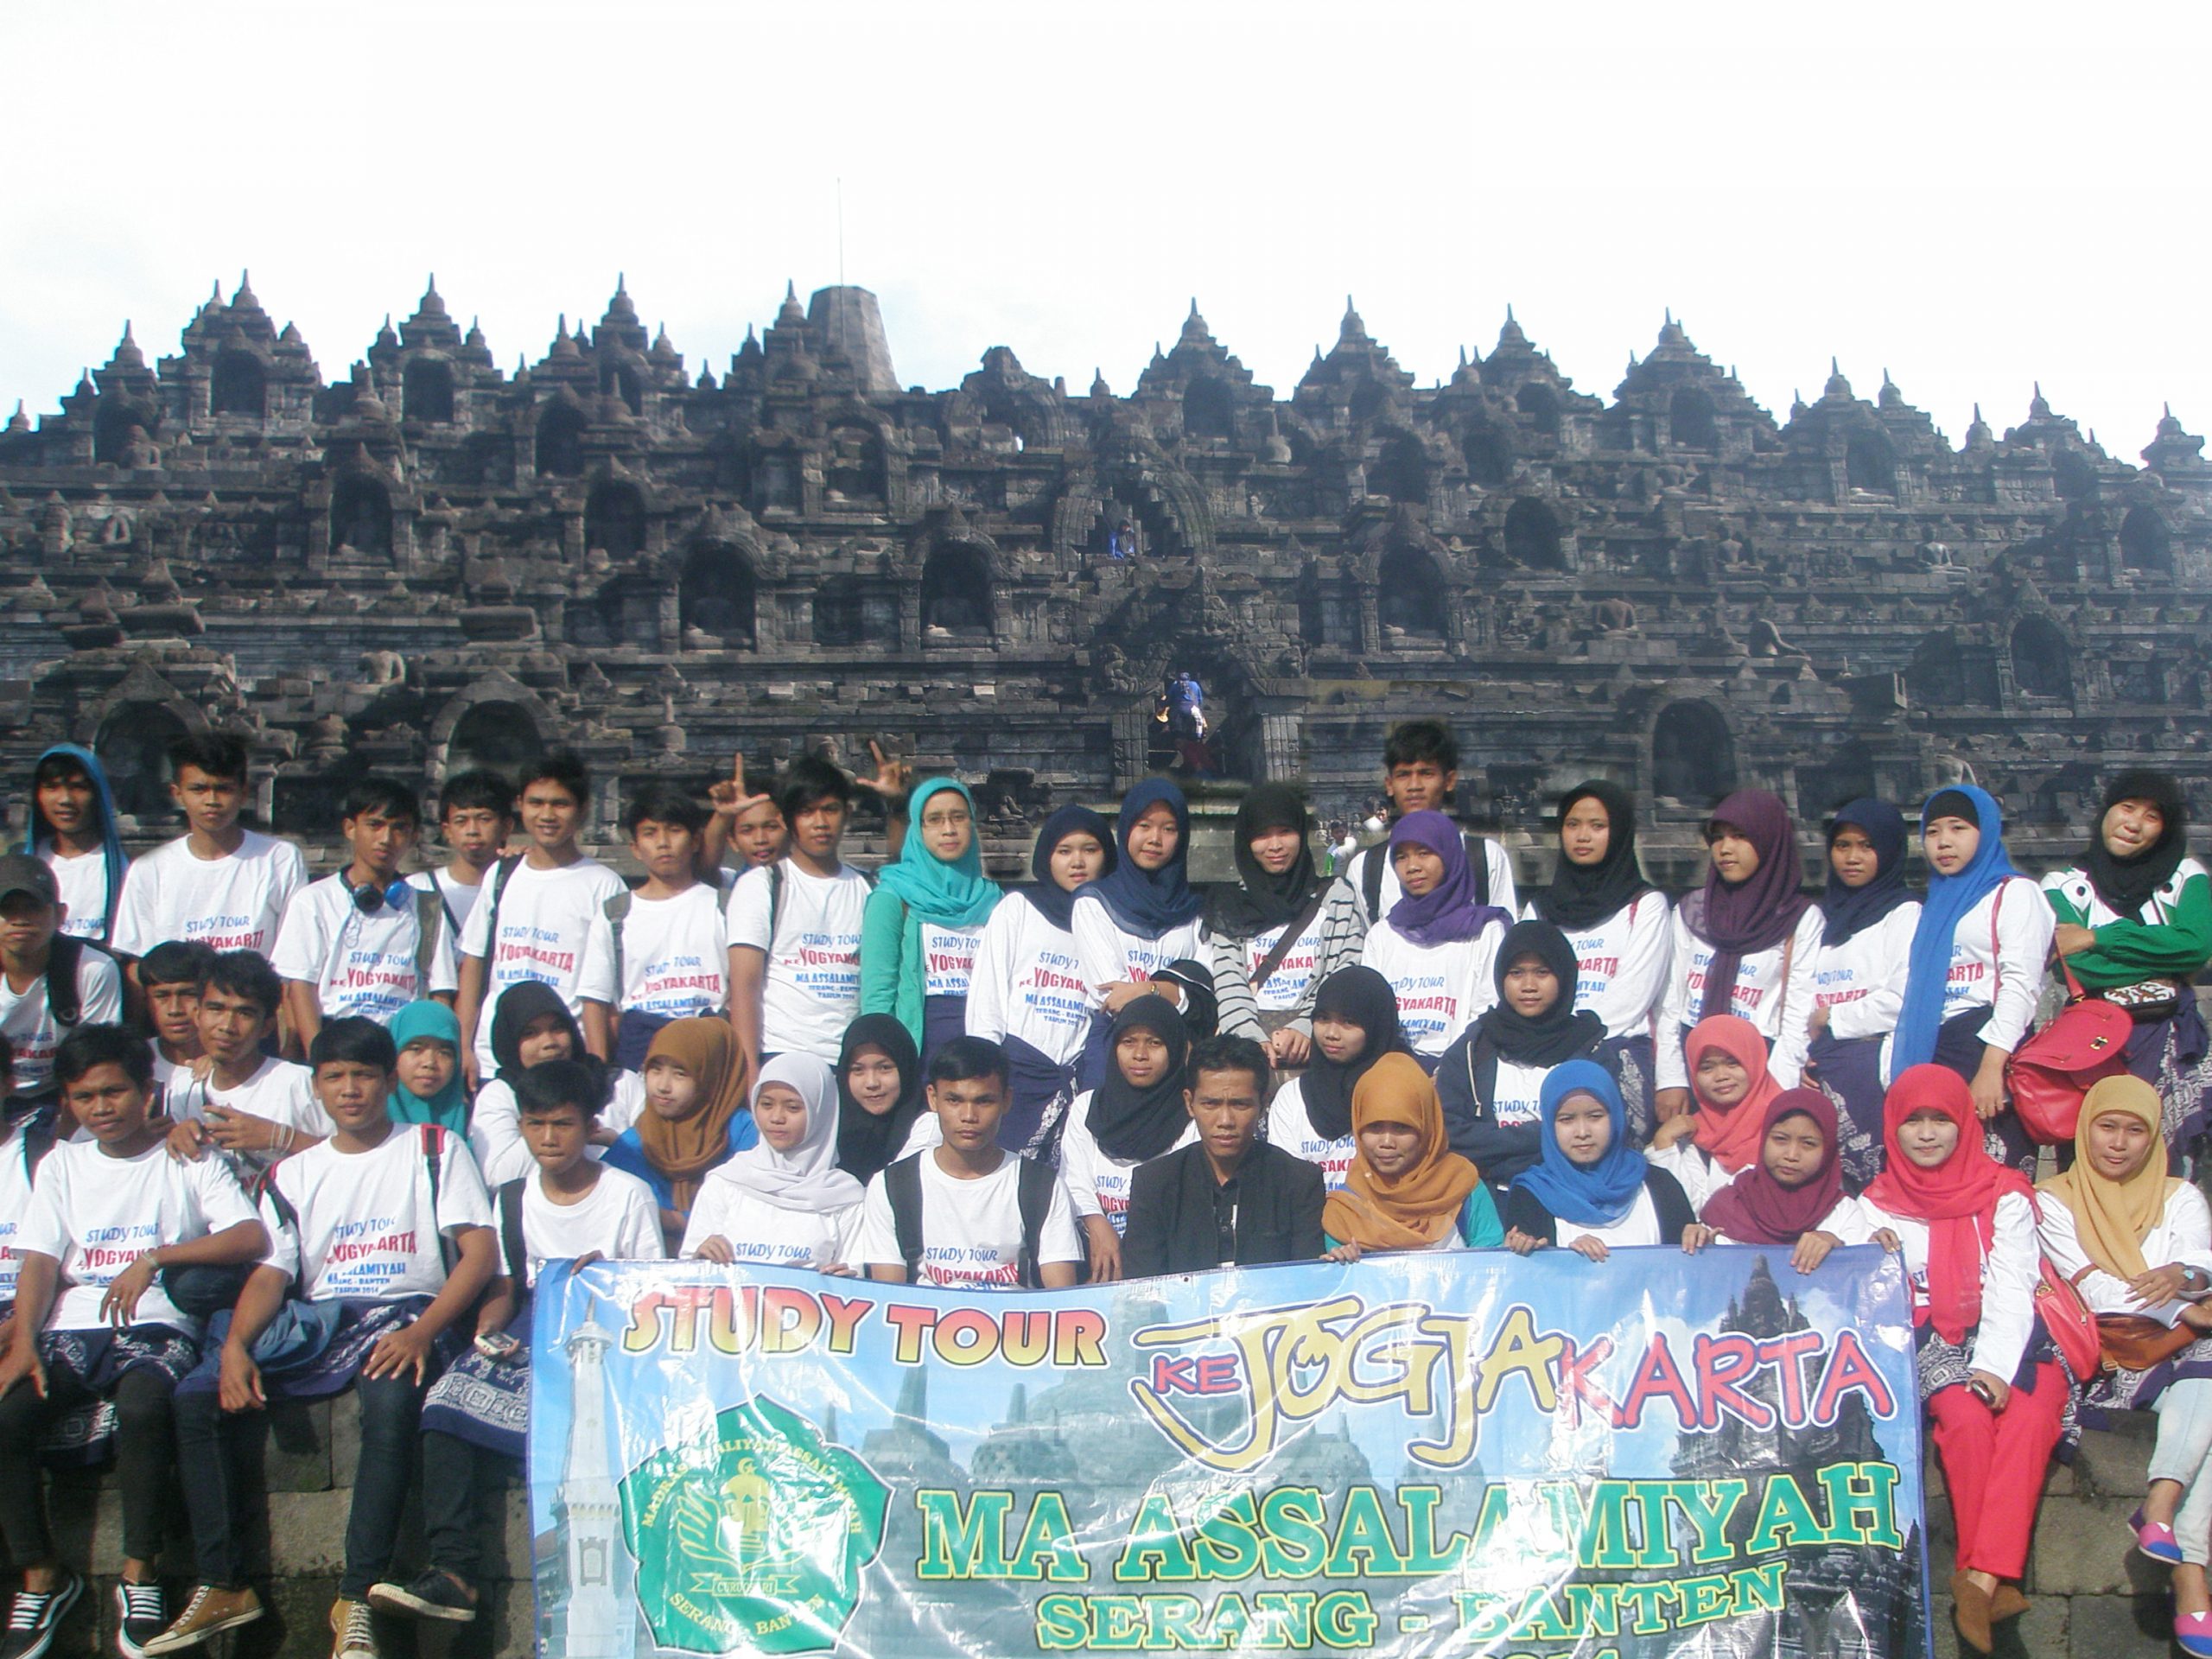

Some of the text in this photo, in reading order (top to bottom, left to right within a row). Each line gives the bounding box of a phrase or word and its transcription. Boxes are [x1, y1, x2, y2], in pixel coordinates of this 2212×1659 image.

[219, 916, 250, 928] TOUR
[531, 928, 560, 943] TOUR
[802, 933, 862, 948] STUDY TOU
[931, 936, 982, 951] STUDY TO
[1255, 938, 1321, 948] STU OUR
[1576, 938, 1605, 951] TOUR
[674, 957, 702, 968] TOUR
[929, 953, 975, 974] YOGYAK
[1039, 952, 1072, 969] STUDY
[1576, 957, 1618, 979] KARTA
[1418, 976, 1445, 988] TOUR
[1395, 996, 1457, 1020] GYAKARTA
[1493, 1100, 1530, 1115] STUDY
[1300, 1136, 1356, 1154] STUDY TOU
[1096, 1175, 1128, 1192] STUDY
[86, 1227, 130, 1243] STUDY
[736, 1243, 812, 1260] STUDY TOUR
[926, 1247, 998, 1263] STUDY TOUR
[622, 1285, 874, 1356] STUDY
[886, 1303, 1111, 1368] TOUR
[1154, 1355, 1237, 1395] KE
[916, 1460, 1904, 1582] MA ASSALAMIYAH
[1036, 1591, 1379, 1649] SERANG
[1453, 1561, 1786, 1642] BANTEN
